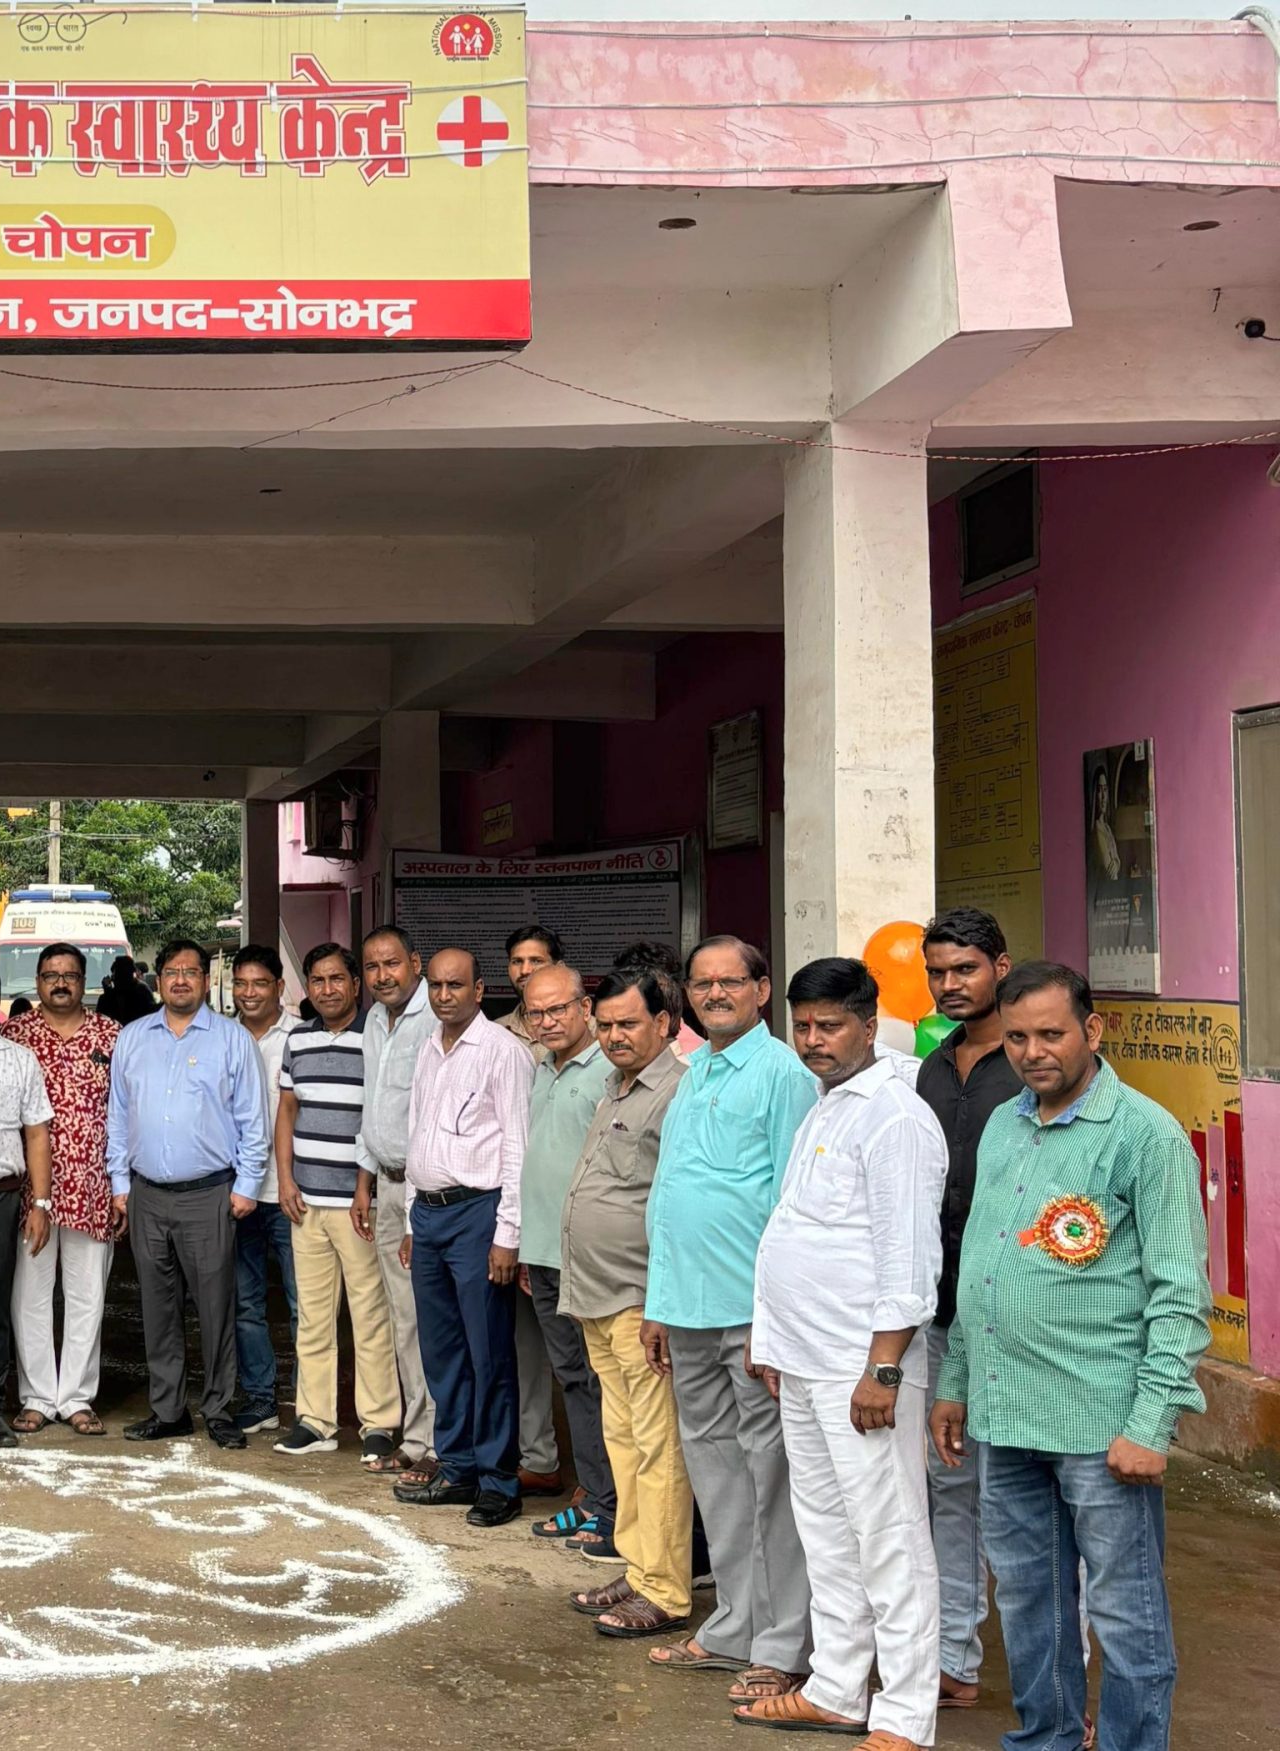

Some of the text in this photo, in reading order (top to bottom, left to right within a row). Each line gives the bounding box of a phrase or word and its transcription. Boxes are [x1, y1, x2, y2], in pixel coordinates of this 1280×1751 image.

[487, 17, 503, 56] MISSION
[62, 80, 271, 179] स्वास्थ्य
[276, 53, 412, 187] केन्द्र
[1, 214, 154, 262] चोपन
[49, 286, 417, 338] जनपद-सोनभद्र
[401, 852, 645, 875] अस्पताल के लिए स्तनपान नीति
[13, 918, 35, 928] 108
